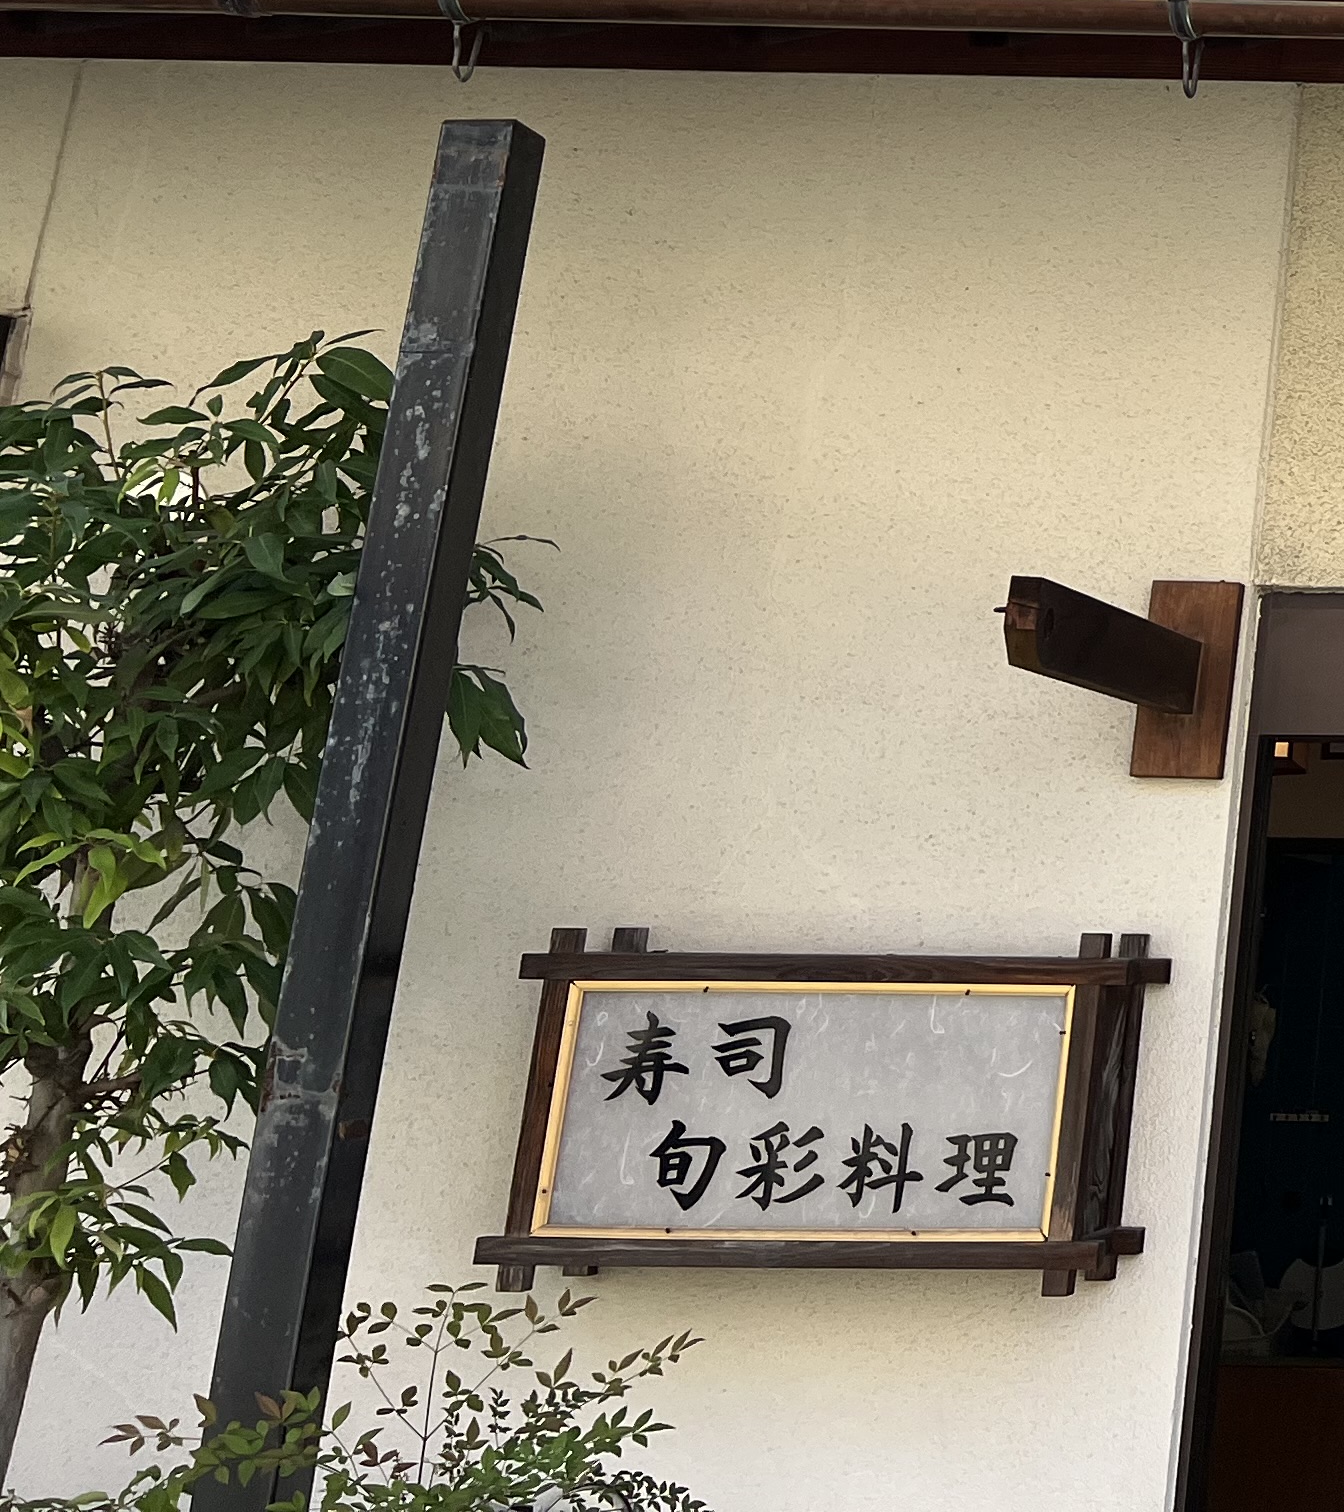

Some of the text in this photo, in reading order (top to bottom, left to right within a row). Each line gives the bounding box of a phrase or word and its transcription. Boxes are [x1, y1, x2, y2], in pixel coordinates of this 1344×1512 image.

[599, 1010, 792, 1106] 寿司
[648, 1119, 1019, 1214] 旬彩料理
